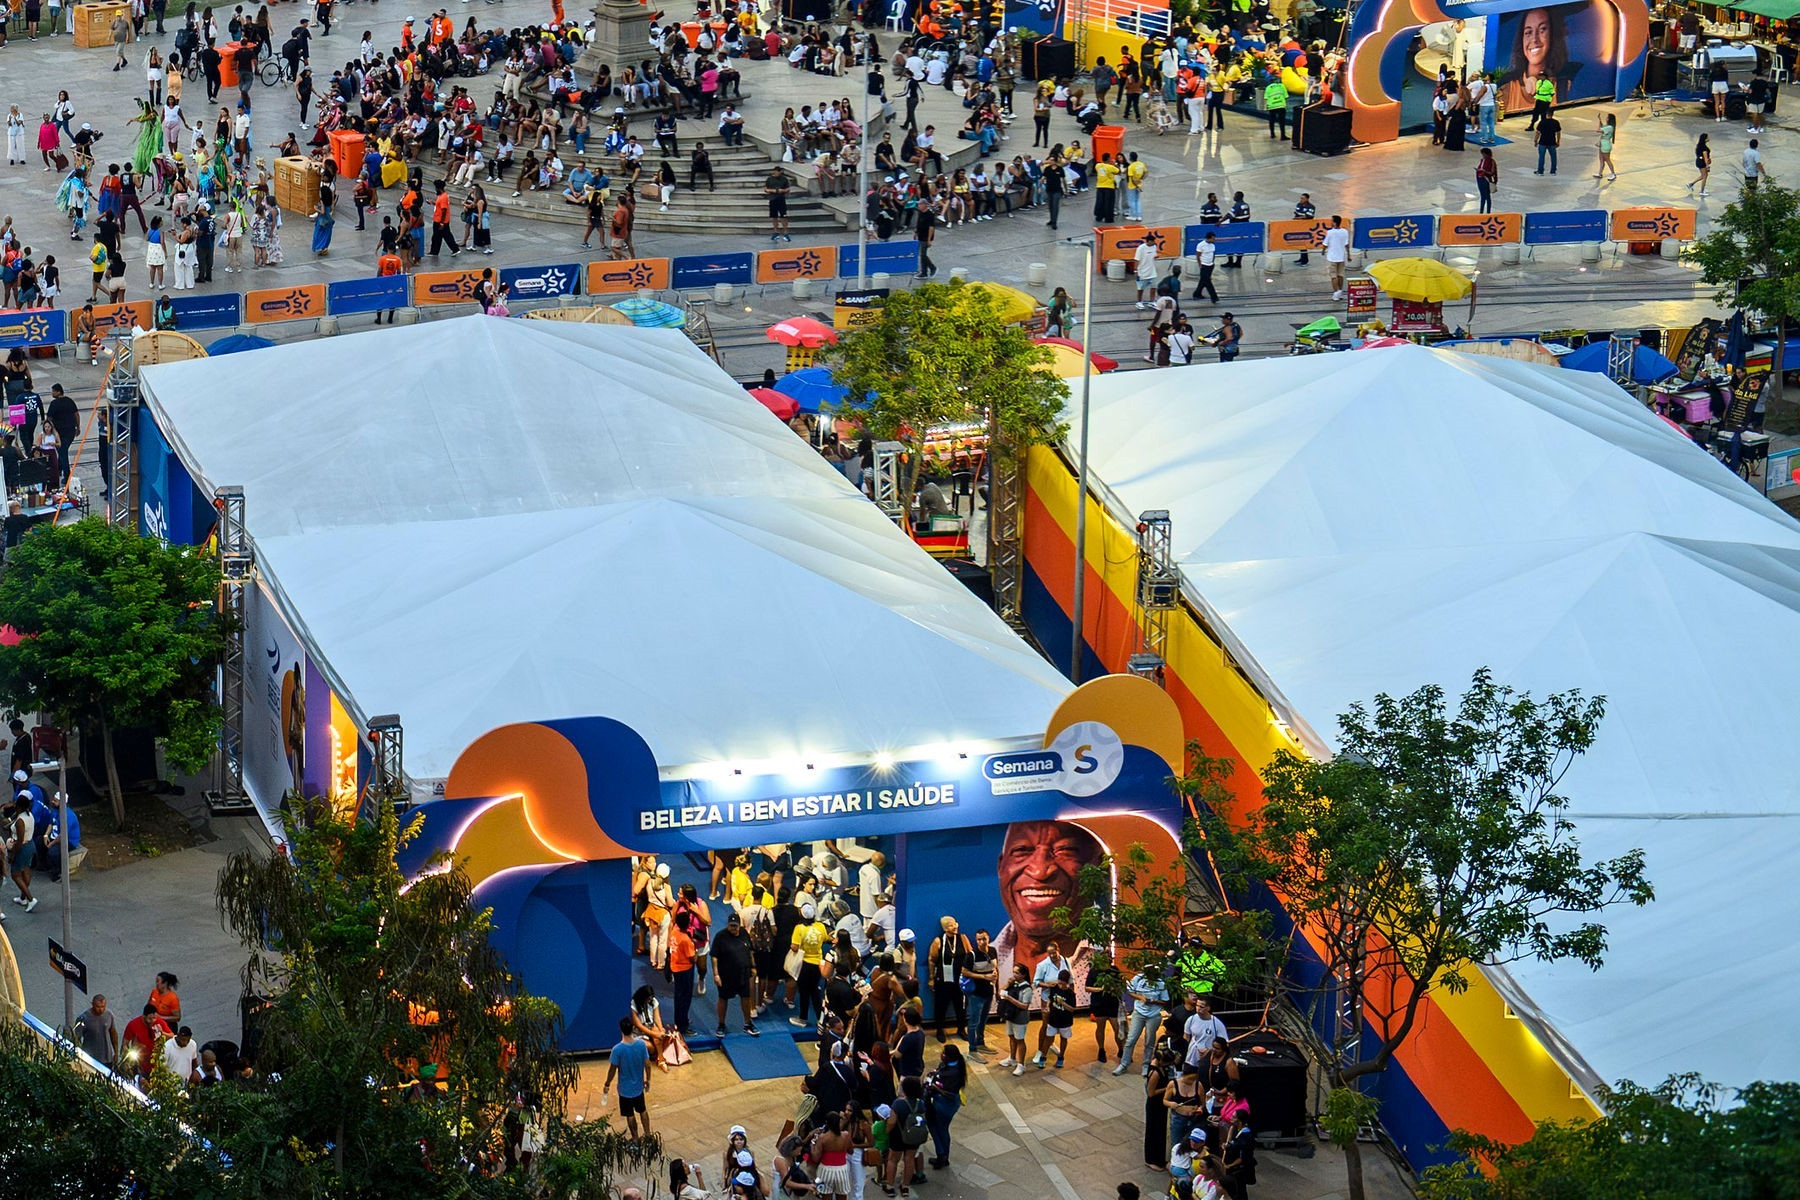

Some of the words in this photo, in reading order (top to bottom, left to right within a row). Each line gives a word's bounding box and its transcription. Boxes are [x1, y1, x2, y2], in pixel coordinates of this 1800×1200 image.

[992, 759, 1054, 775] Semana
[640, 804, 723, 831] BELEZA
[740, 798, 789, 822] BEM
[793, 792, 862, 817] ESTAR
[877, 781, 955, 809] SAÚDE
